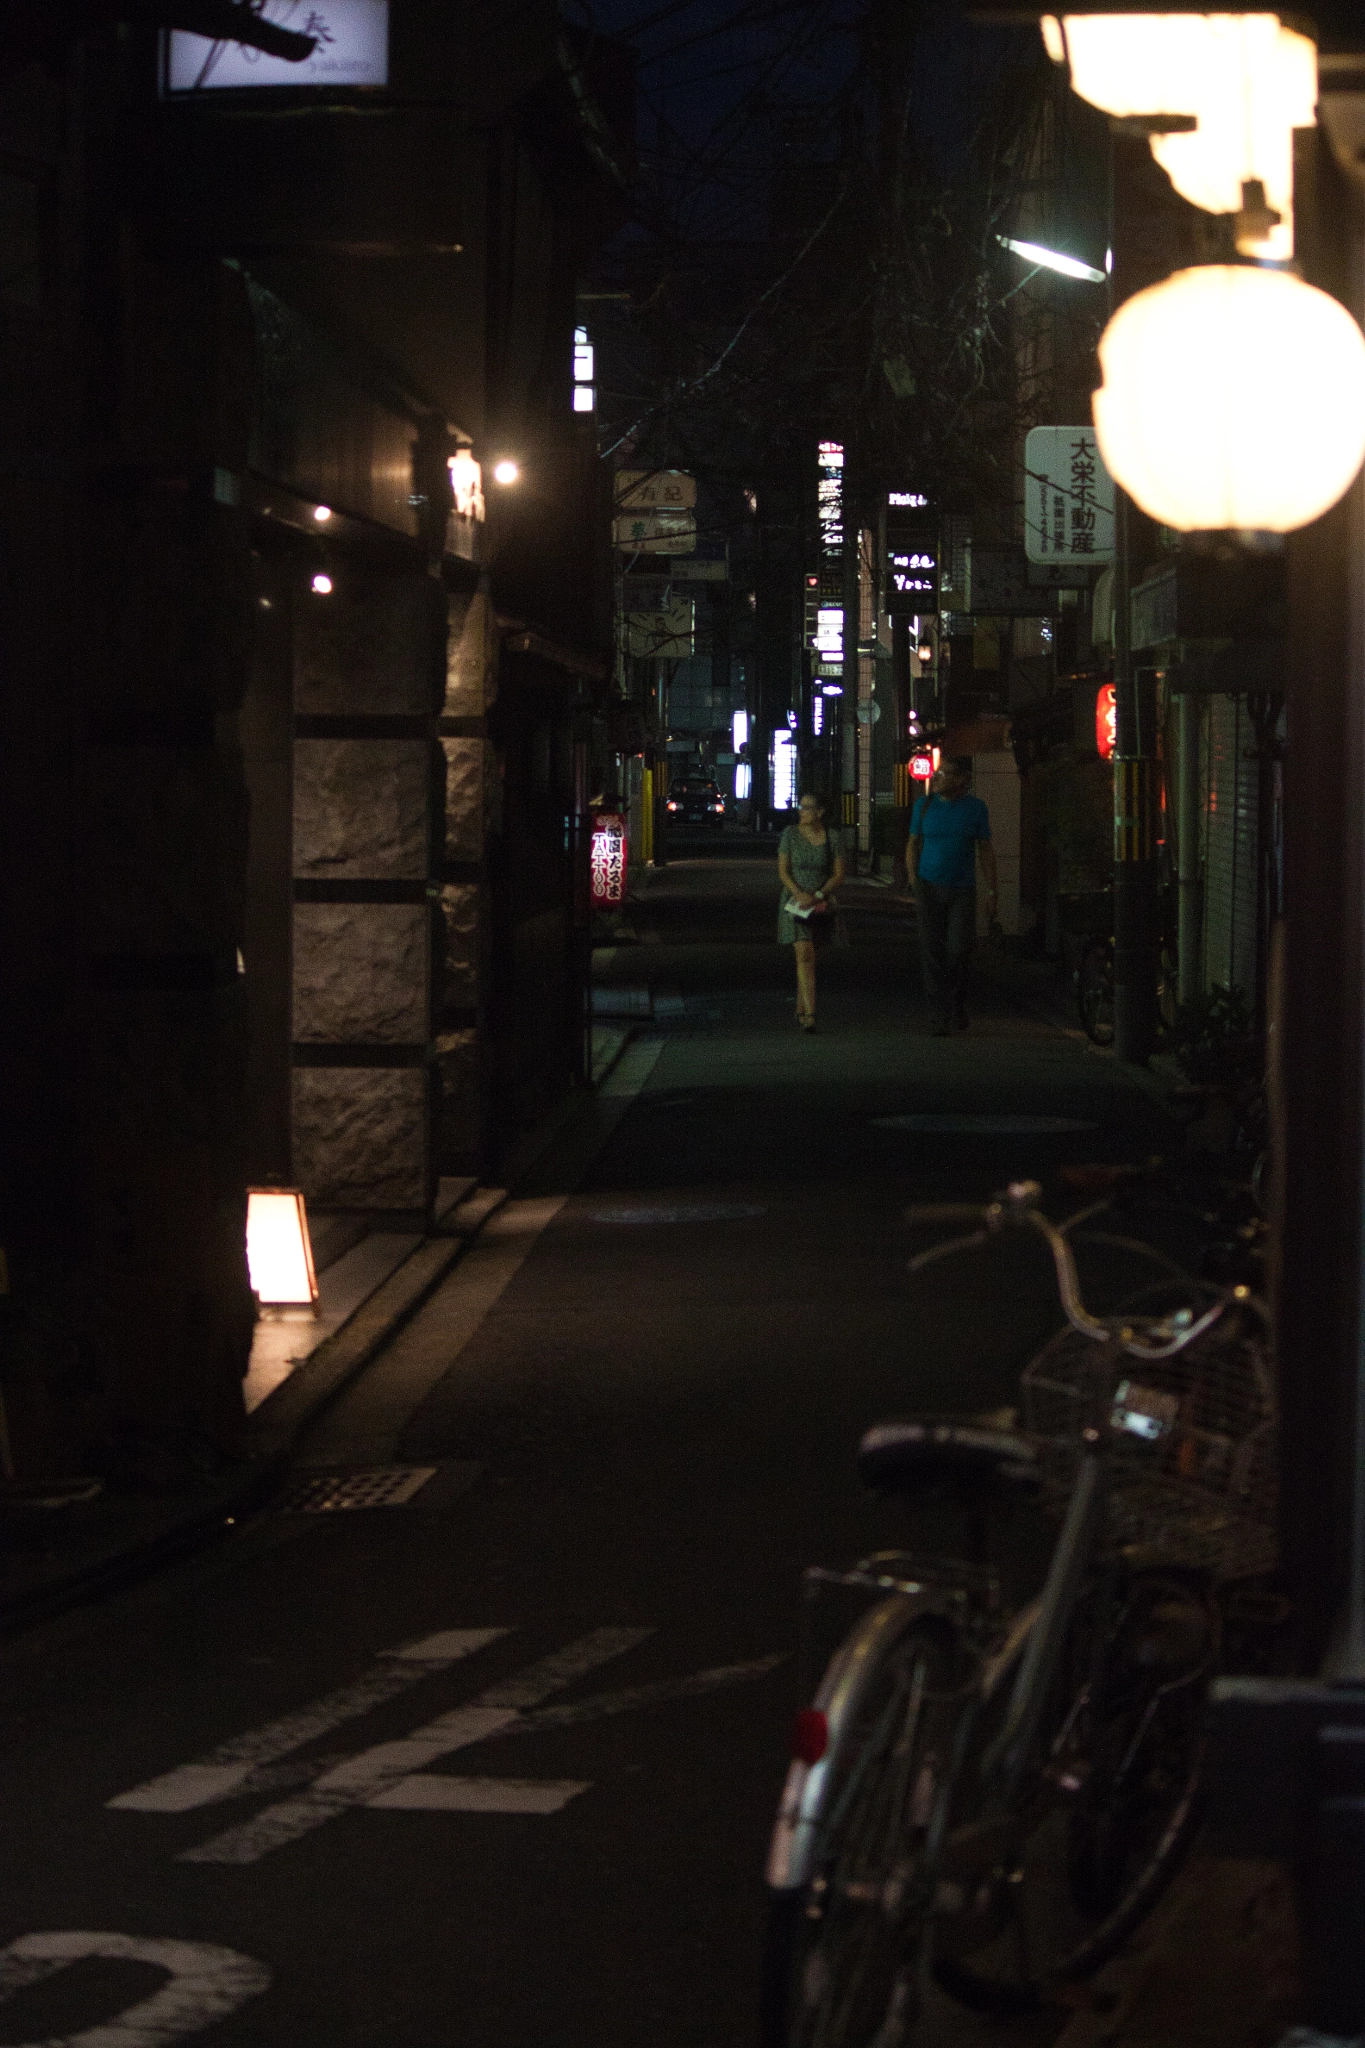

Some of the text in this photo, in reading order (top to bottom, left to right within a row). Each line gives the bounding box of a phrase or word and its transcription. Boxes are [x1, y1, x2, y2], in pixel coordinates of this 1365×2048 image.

[1070, 436, 1096, 554] 大栄不動産
[593, 833, 606, 896] TATTOO
